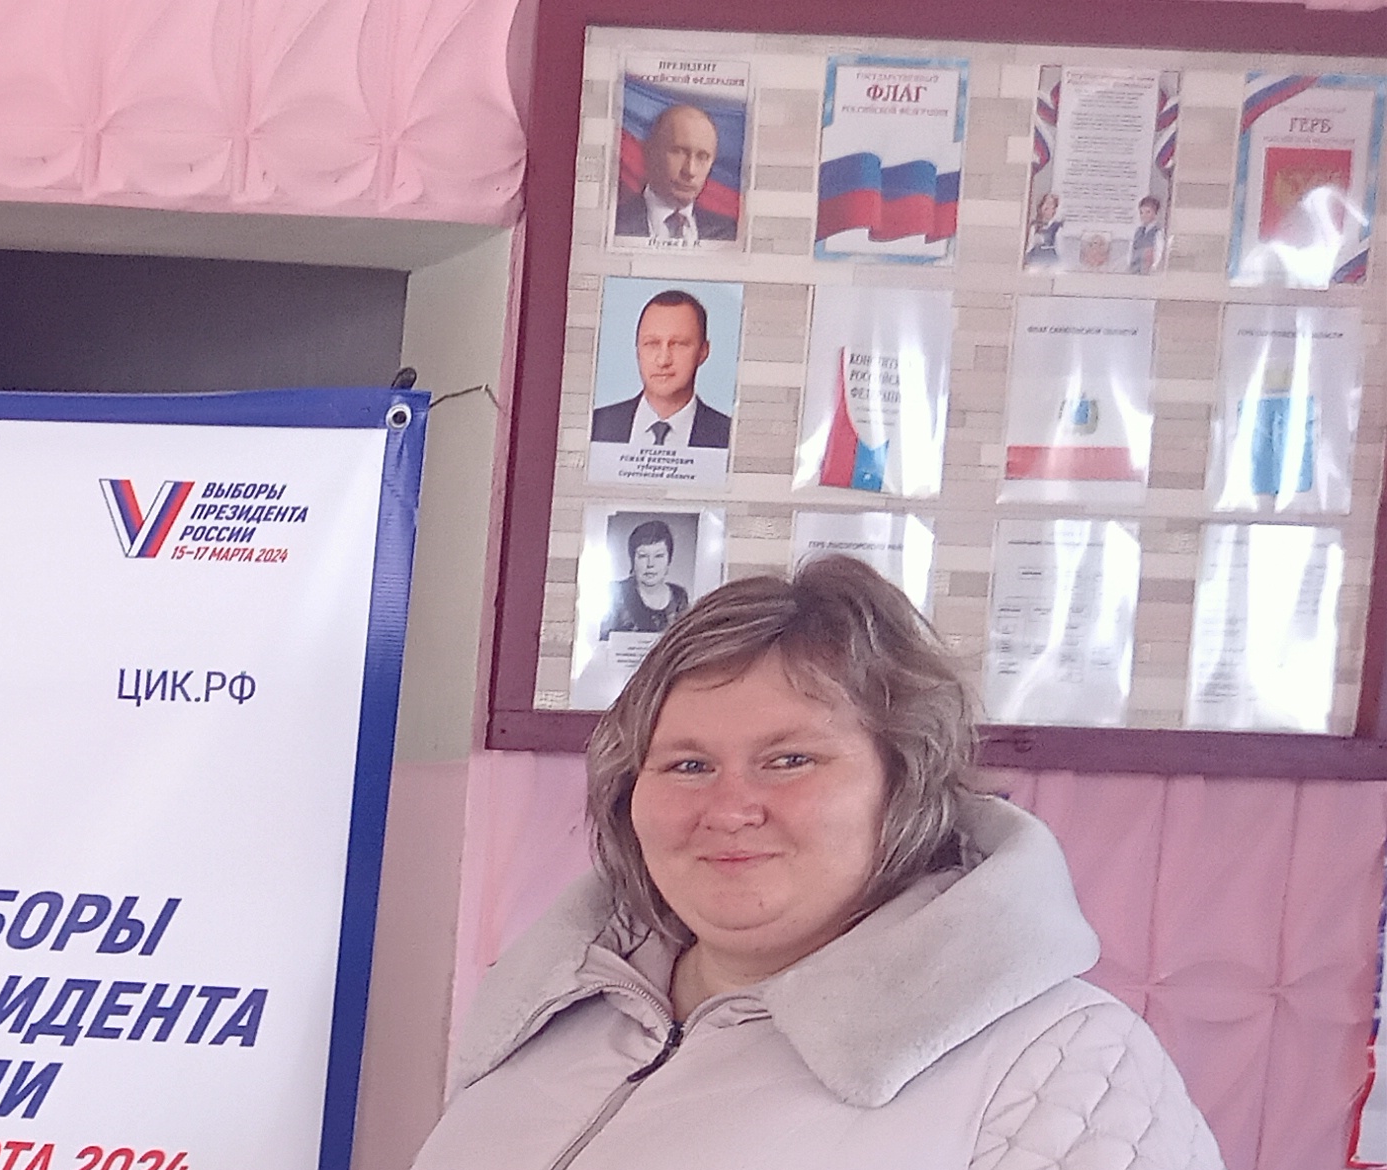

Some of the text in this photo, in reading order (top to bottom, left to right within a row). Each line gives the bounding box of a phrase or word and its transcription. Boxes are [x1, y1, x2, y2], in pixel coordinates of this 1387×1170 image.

[866, 83, 928, 103] ФЛАГ
[1289, 117, 1332, 133] ГЕРБ
[201, 483, 287, 499] ВЫБОРЫ
[190, 504, 310, 523] ПРЕЗИДЕНТА
[179, 526, 256, 542] РОССИИ
[207, 548, 254, 562] МАРТА
[254, 550, 289, 563] 2024
[117, 668, 256, 708] ЦИК.РФ
